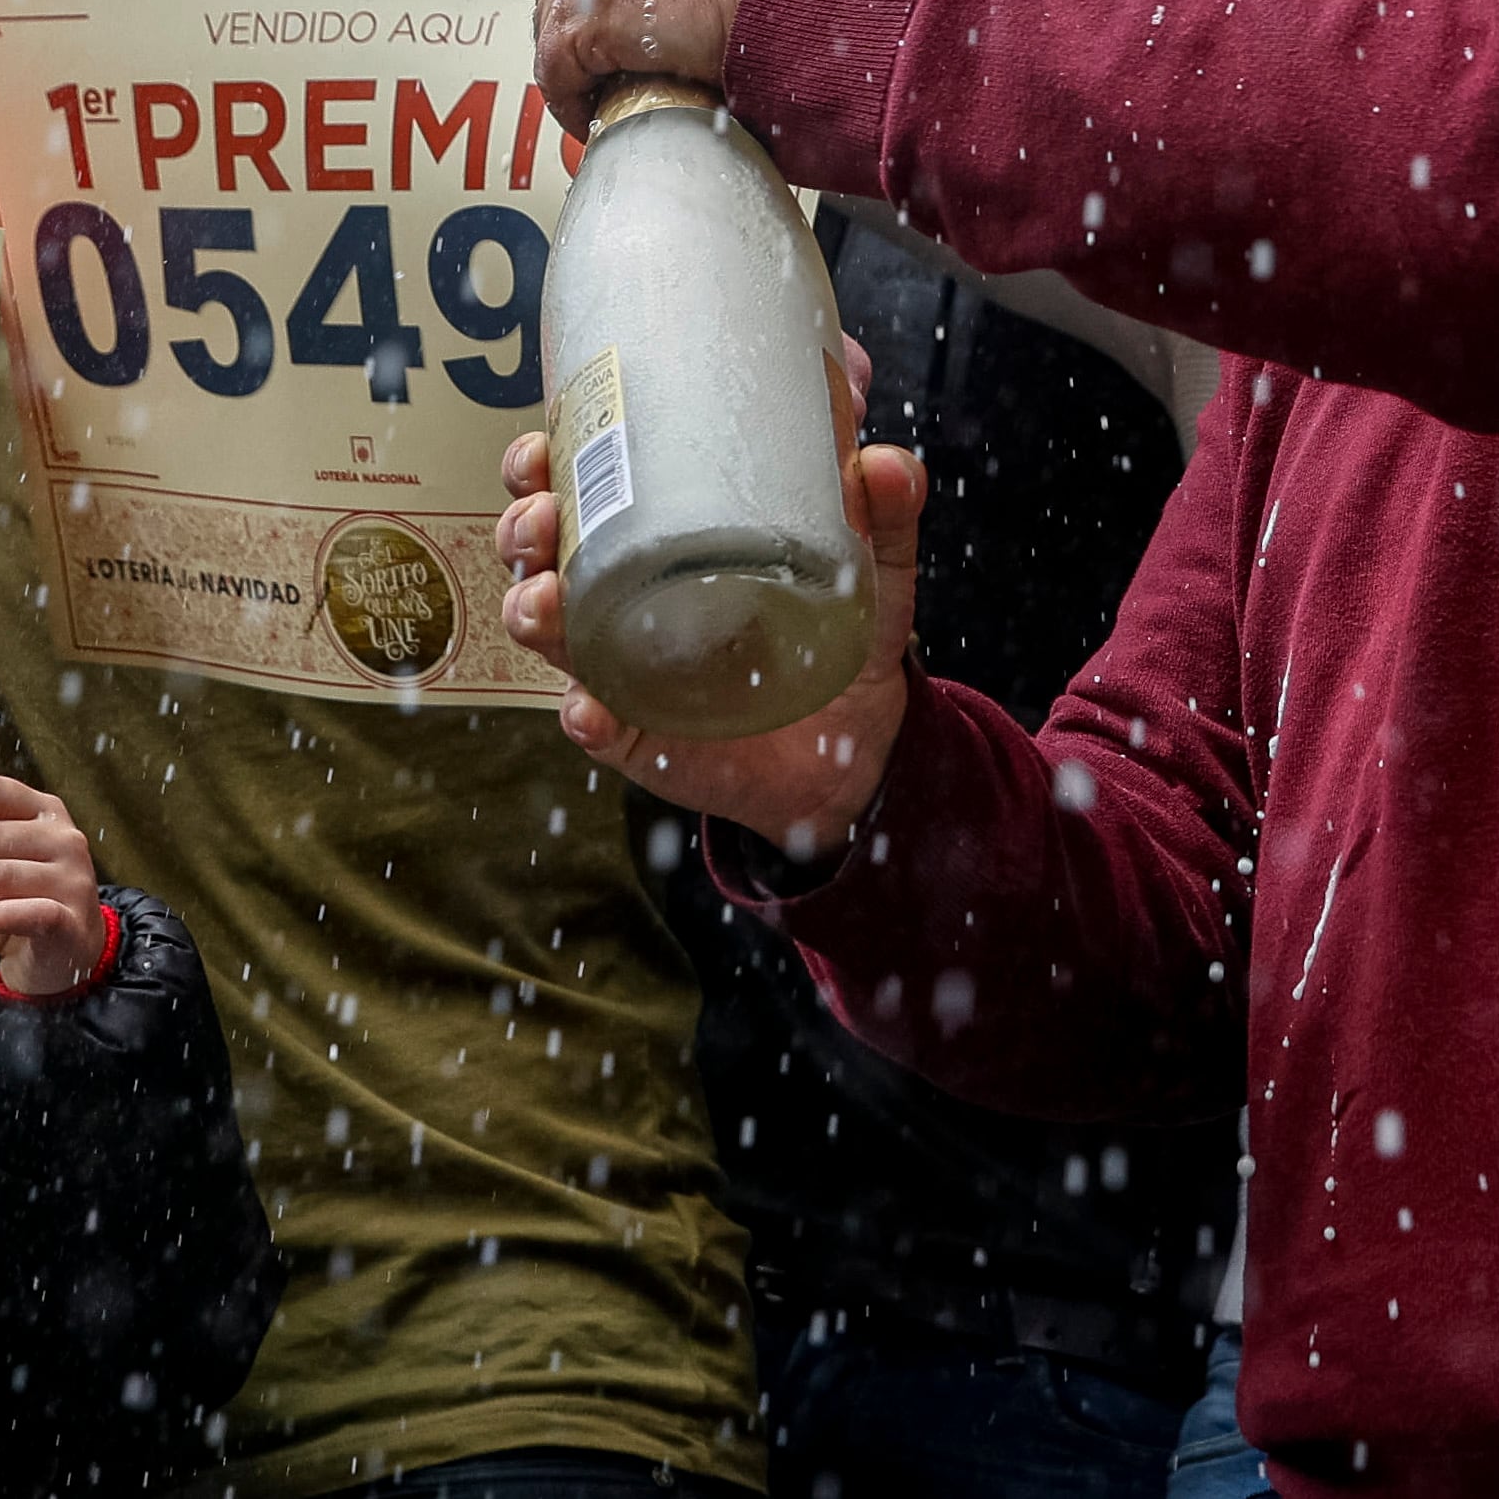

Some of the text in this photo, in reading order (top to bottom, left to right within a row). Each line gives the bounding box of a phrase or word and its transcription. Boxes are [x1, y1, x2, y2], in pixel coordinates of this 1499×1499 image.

[204, 10, 501, 46] VENDIDO AQUÍ
[131, 78, 590, 192] PREMI
[583, 366, 615, 397] CAVA
[361, 473, 422, 486] NACIONAL
[86, 557, 176, 588] LOTERÍA
[201, 571, 301, 605] NAVIDAD
[342, 561, 428, 606] SORTEO
[358, 613, 421, 662] UNE
